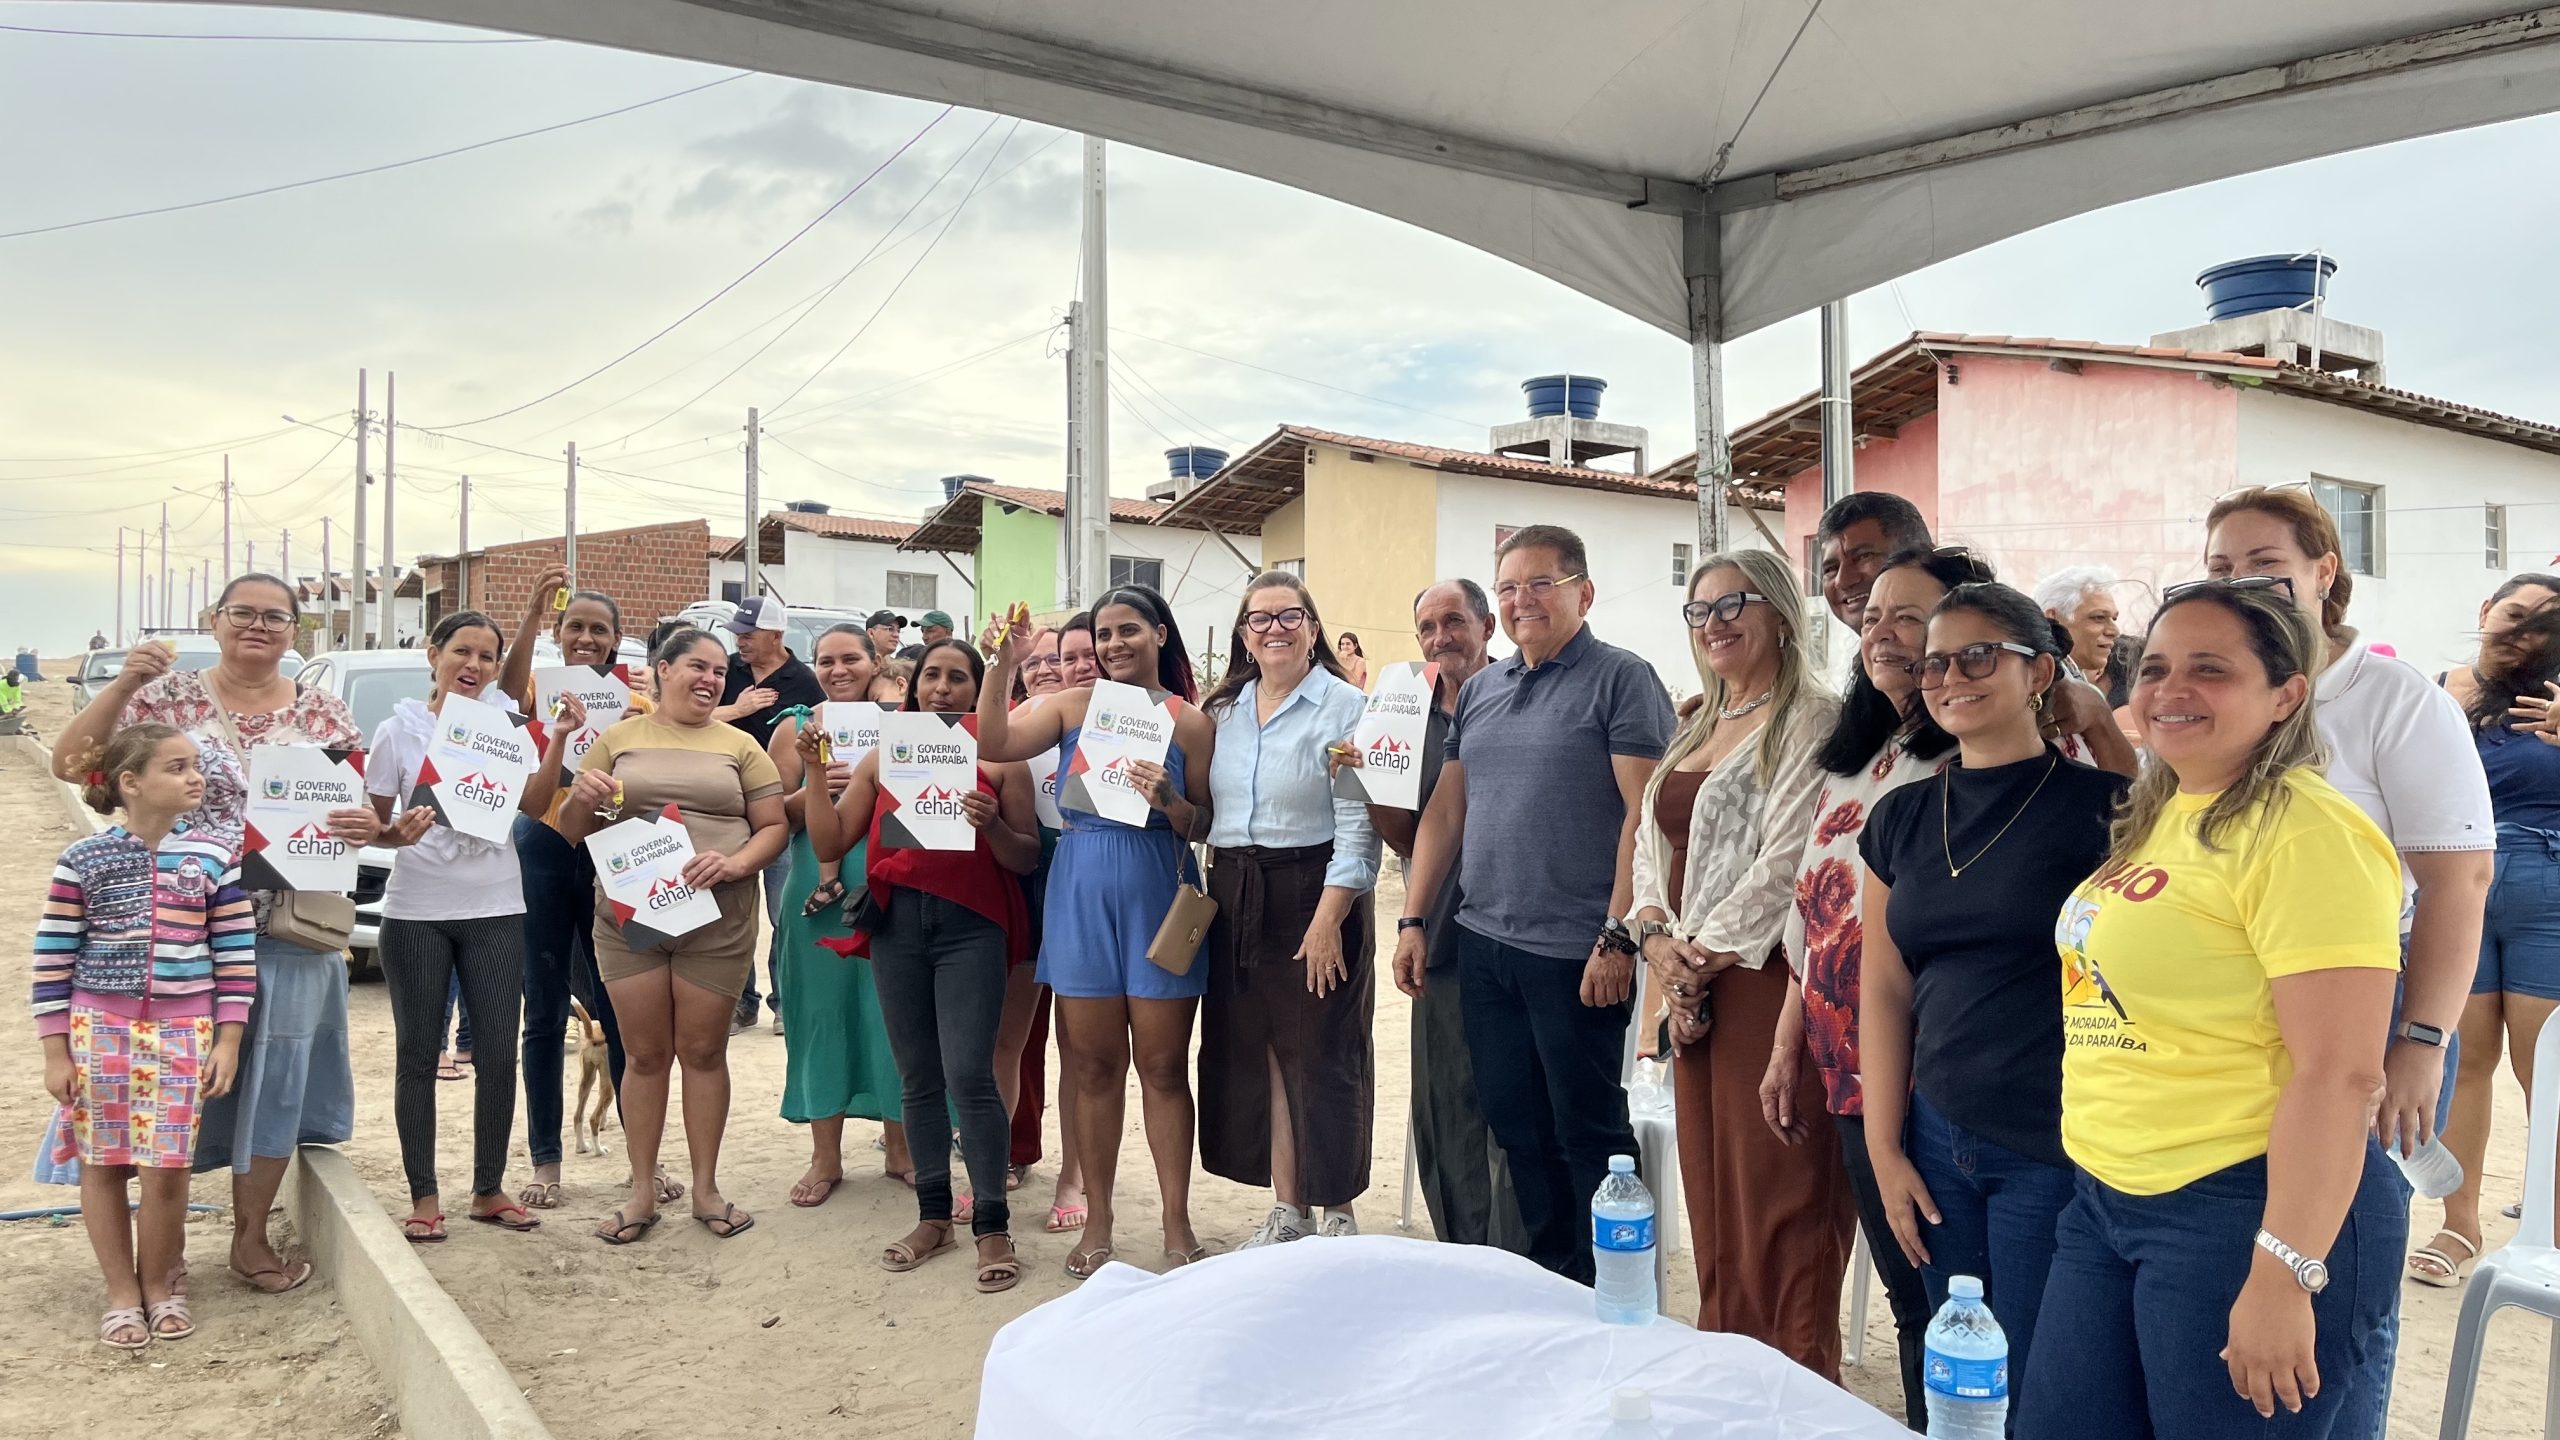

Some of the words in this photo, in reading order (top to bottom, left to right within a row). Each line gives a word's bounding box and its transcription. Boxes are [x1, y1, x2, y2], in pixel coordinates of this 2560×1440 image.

[1385, 692, 1418, 704] GOVERNO
[1380, 703, 1390, 712] DA
[1120, 715, 1159, 732] GOVERNO
[475, 732, 520, 753] GOVERNO
[857, 739, 870, 747] DA
[1117, 726, 1128, 736] DA
[1129, 728, 1162, 743] PARAÍBA
[472, 741, 485, 753] DA
[486, 745, 523, 765] PARAÍBA
[917, 744, 961, 754] GOVERNO
[917, 755, 930, 764] DA
[931, 754, 968, 765] PARAÍBA
[1368, 747, 1410, 775] cehap
[296, 780, 347, 792] GOVERNO
[294, 791, 310, 801] DA
[311, 792, 353, 803] PARAÍBA
[455, 783, 505, 812] cehap
[915, 796, 964, 820] cehap
[287, 834, 345, 861] cehap
[631, 835, 673, 857] GOVERNO
[634, 856, 648, 867] DA
[647, 841, 684, 861] PARAÍBA
[649, 884, 696, 910] cehap
[2069, 1016, 2117, 1029] MORADIA
[2069, 1034, 2084, 1046] DA
[2086, 1033, 2147, 1052] PARAÍBA
